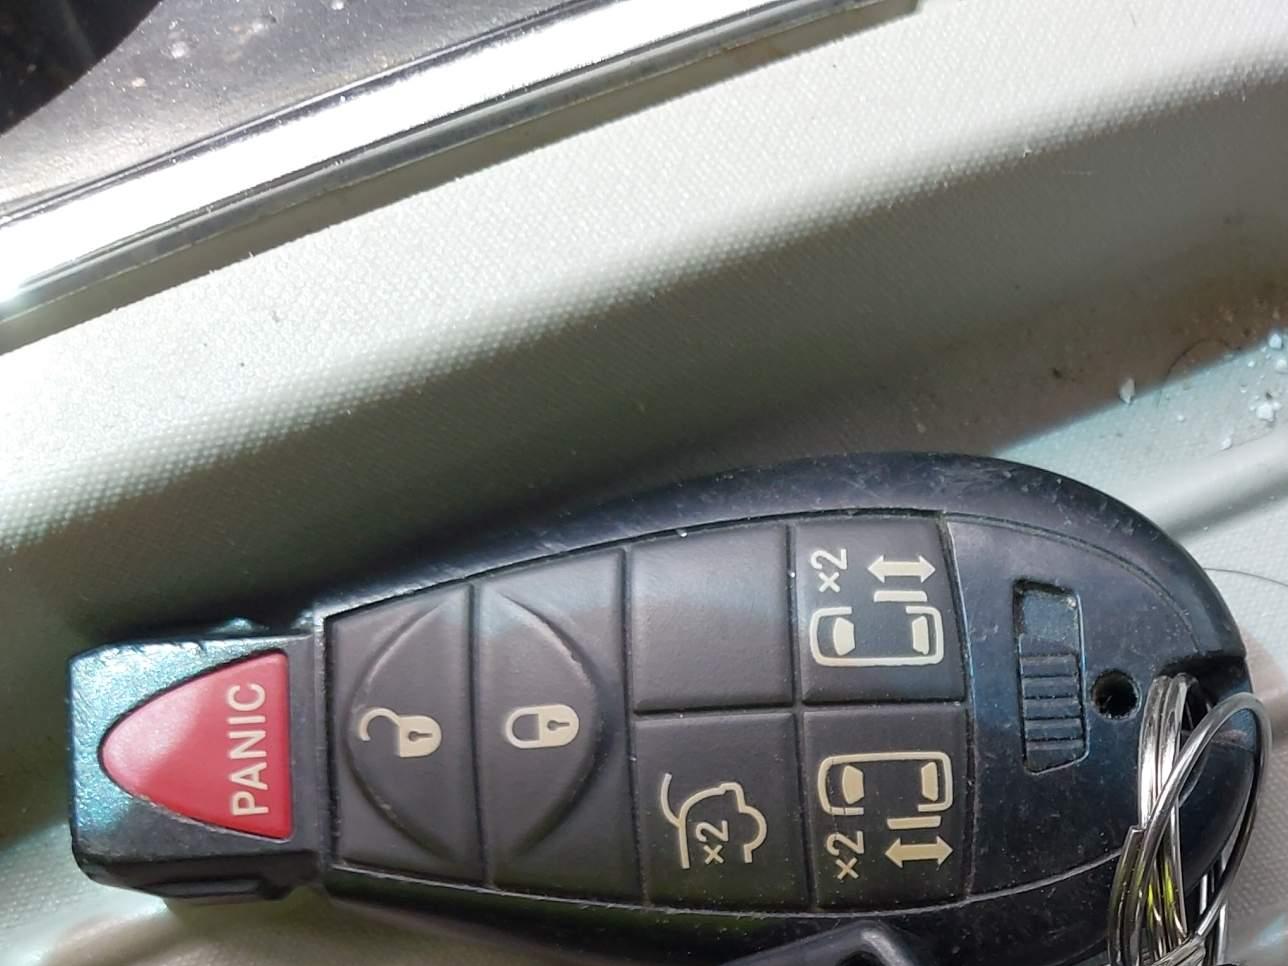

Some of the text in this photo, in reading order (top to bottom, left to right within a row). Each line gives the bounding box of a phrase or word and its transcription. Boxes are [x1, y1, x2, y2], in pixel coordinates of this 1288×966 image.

[810, 548, 848, 593] x2
[226, 682, 269, 817] PANIC
[696, 820, 729, 865] x2
[826, 830, 864, 880] x2
